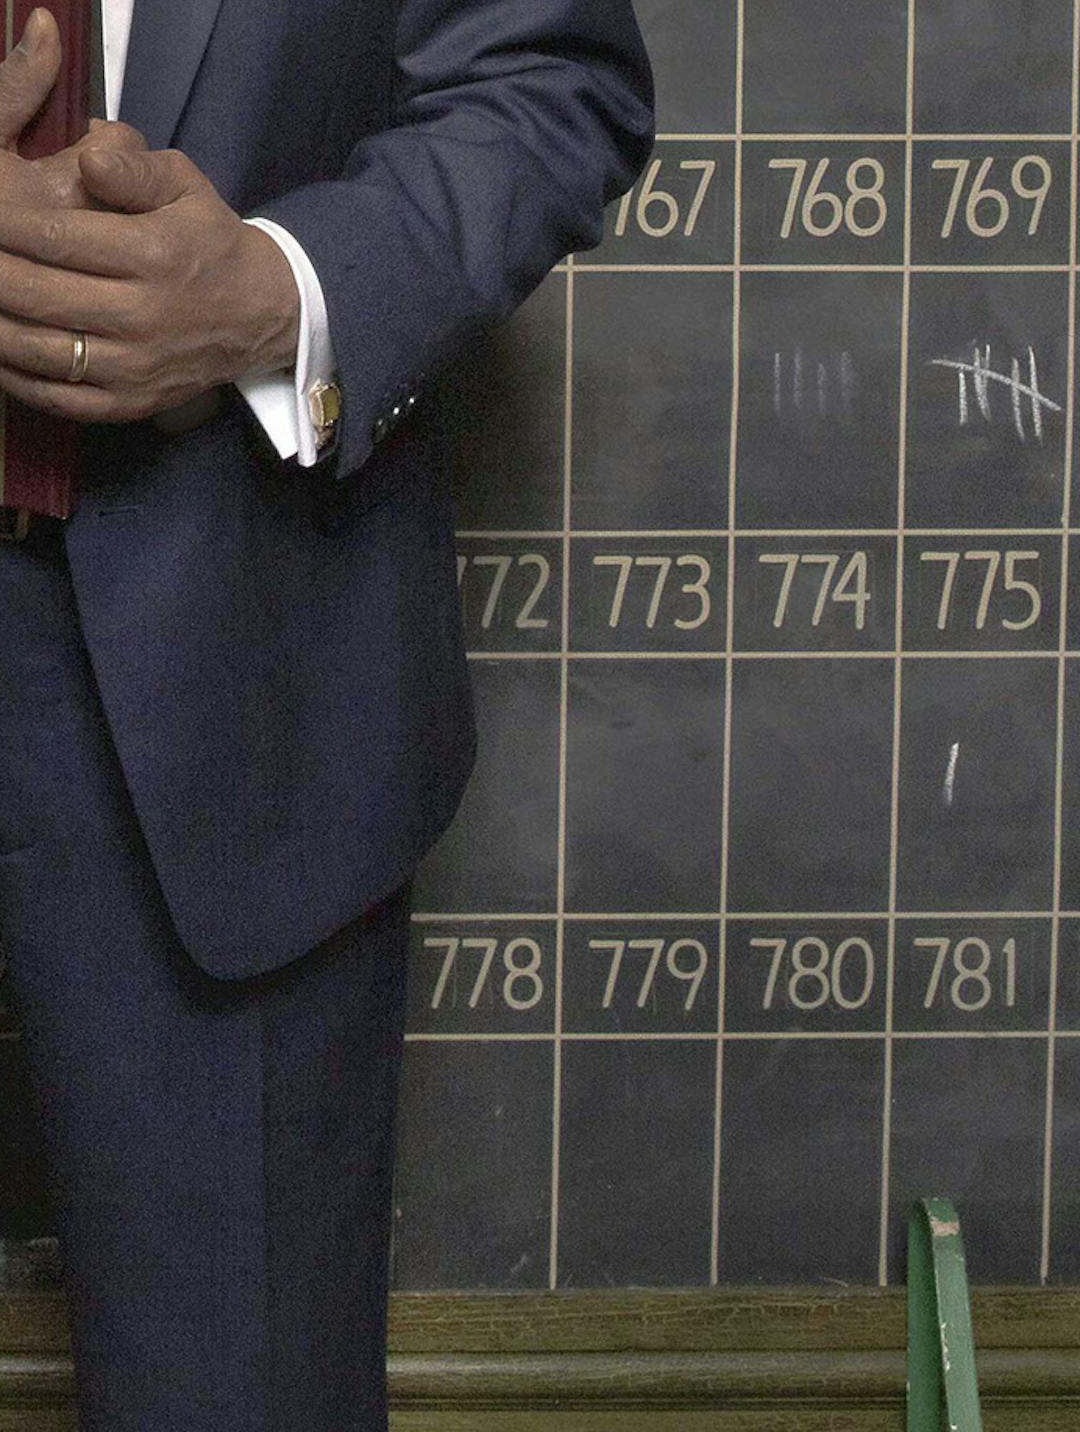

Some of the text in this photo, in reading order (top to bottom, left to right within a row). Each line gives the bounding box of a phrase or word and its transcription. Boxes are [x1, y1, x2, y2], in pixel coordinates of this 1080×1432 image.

[768, 157, 887, 239] 768
[931, 154, 1052, 239] 769
[458, 553, 550, 629] 72
[593, 554, 711, 630] 773
[758, 551, 871, 630] 774
[920, 550, 1041, 631] 775
[424, 937, 544, 1010] 778
[588, 938, 708, 1011] 779
[749, 936, 875, 1009] 780
[913, 936, 1016, 1011] 781
